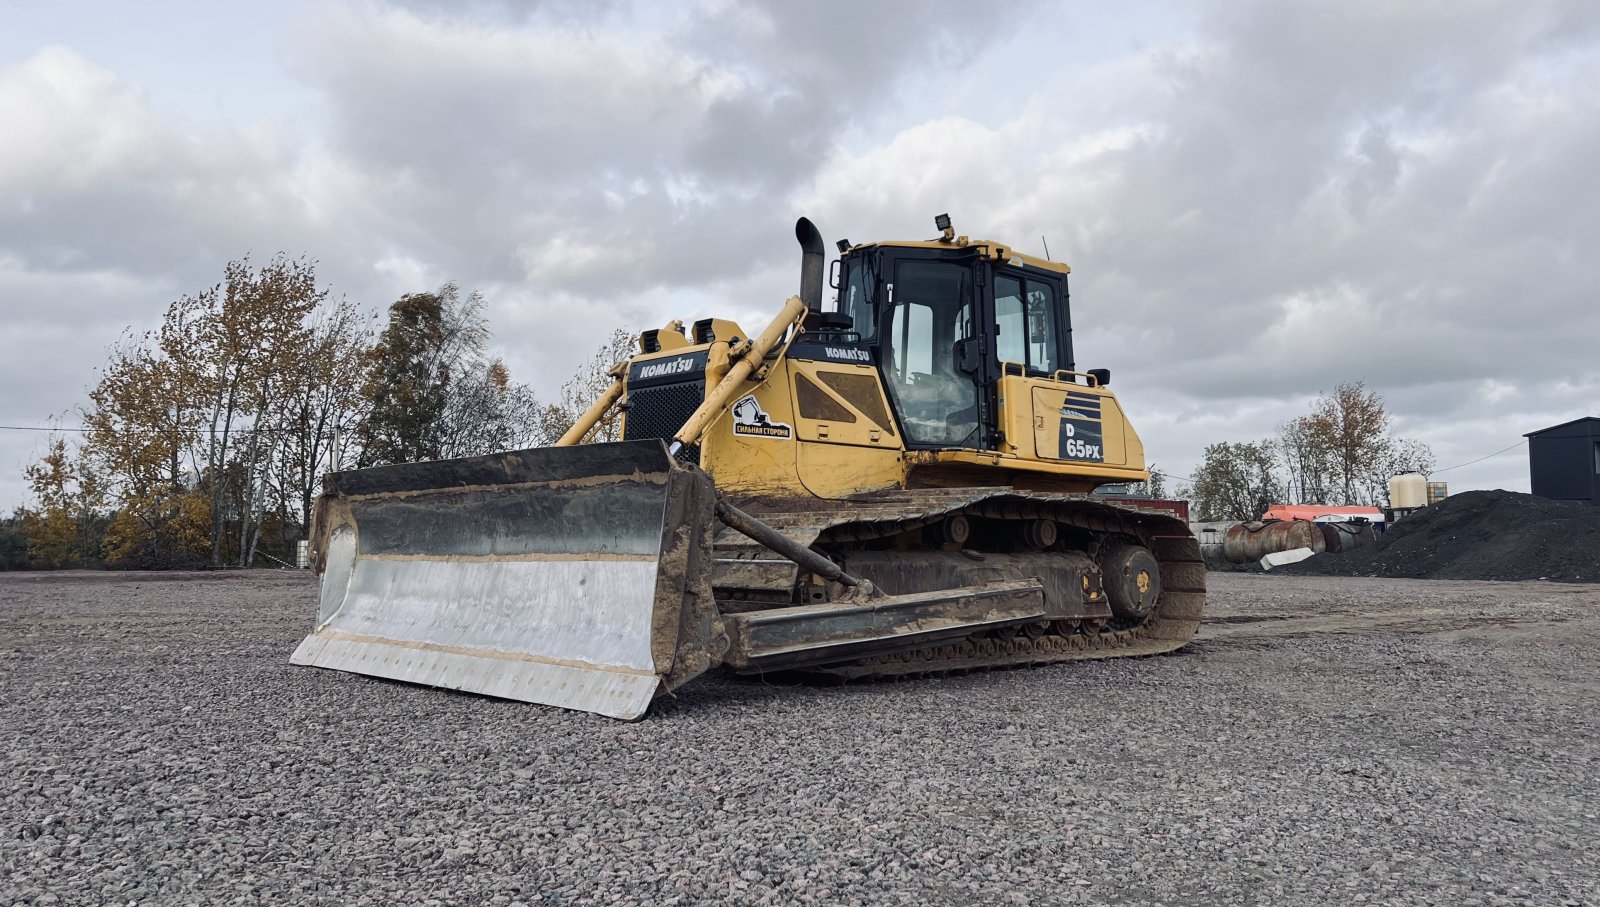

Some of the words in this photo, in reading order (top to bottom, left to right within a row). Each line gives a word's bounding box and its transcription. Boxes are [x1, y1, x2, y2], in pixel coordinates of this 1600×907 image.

[825, 347, 870, 361] KOMATSU
[640, 357, 694, 378] KOMATSU
[736, 425, 763, 435] СИЛЬНАЯ
[763, 427, 789, 437] СТОРОНА
[1065, 423, 1075, 437] D
[1066, 439, 1101, 459] 65PX
